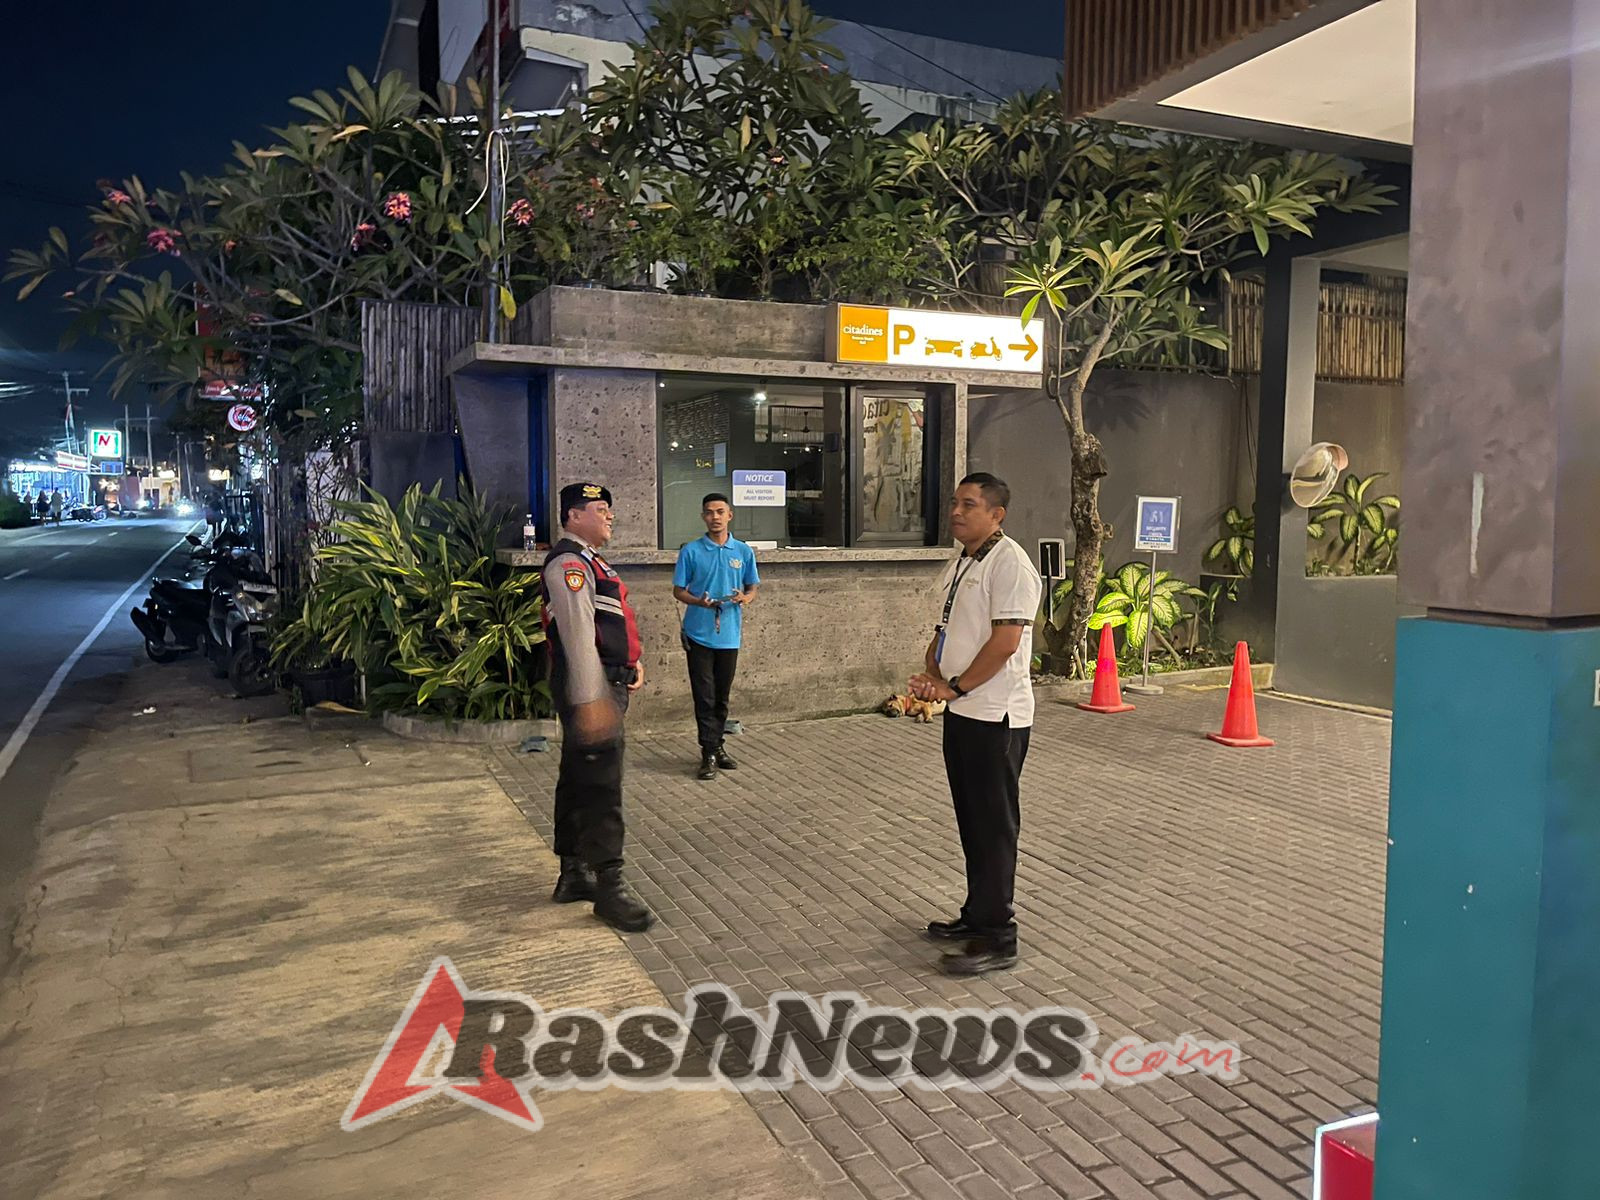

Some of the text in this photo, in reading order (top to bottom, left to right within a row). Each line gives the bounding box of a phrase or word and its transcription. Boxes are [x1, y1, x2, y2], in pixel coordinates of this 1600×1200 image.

[843, 324, 883, 336] citadines
[893, 324, 916, 355] P
[744, 474, 774, 482] NOTICE
